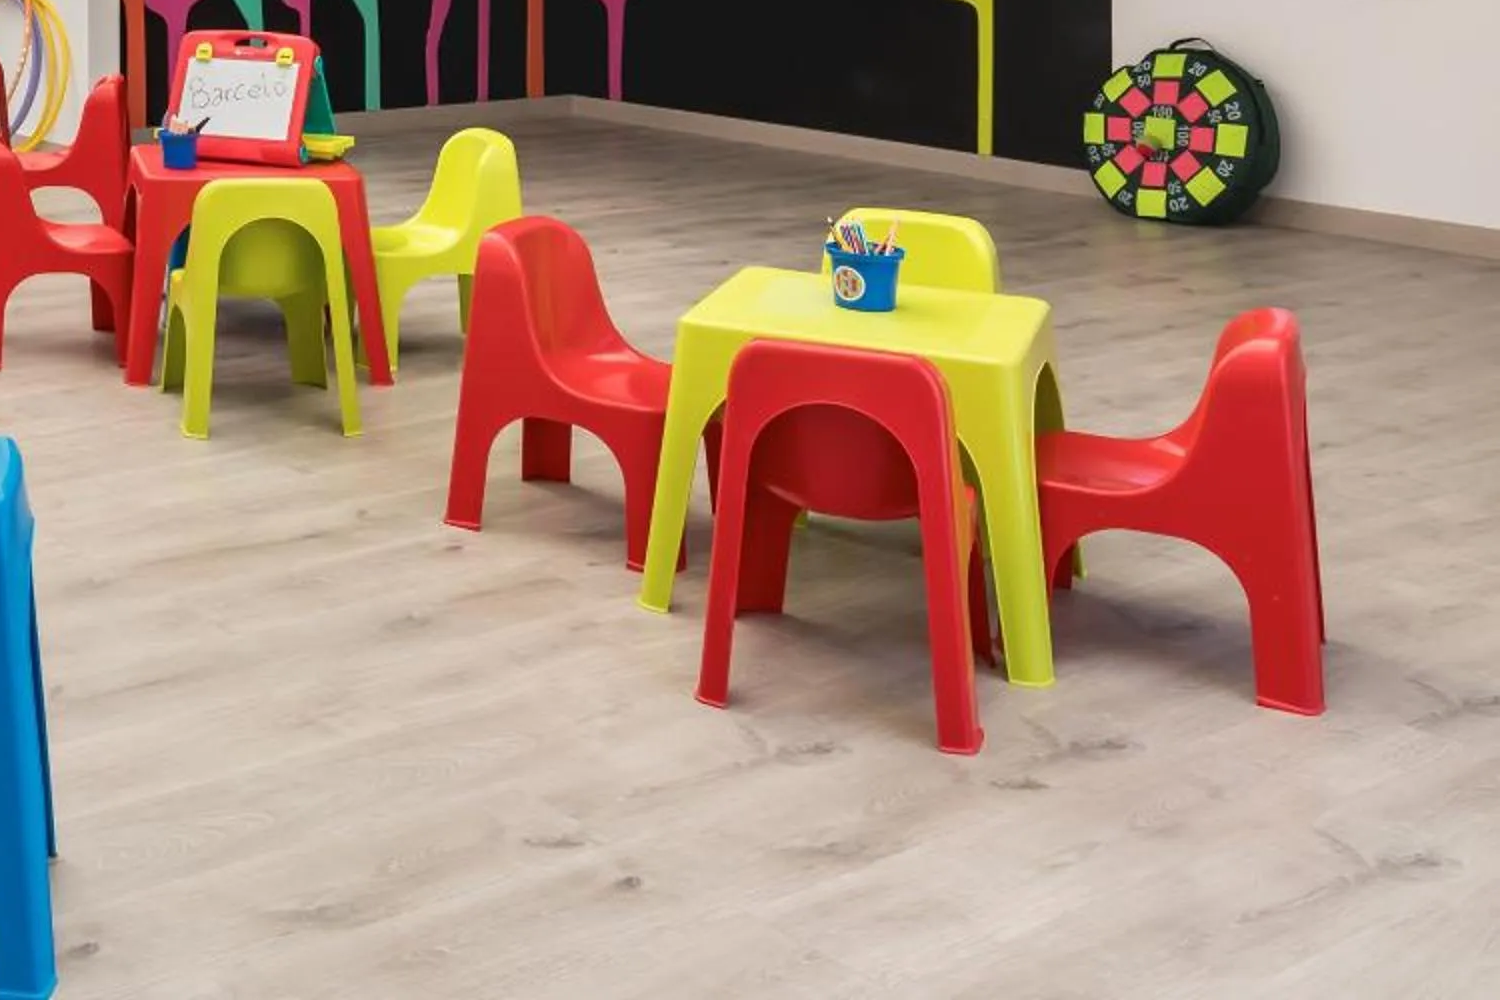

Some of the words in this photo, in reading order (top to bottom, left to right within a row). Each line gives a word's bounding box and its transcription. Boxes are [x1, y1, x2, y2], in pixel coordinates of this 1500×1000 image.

[1188, 62, 1207, 77] 20
[1137, 75, 1151, 88] 50
[1225, 102, 1241, 120] 20
[1177, 126, 1189, 146] 100
[1216, 160, 1234, 177] 20
[1169, 197, 1189, 212] 20
